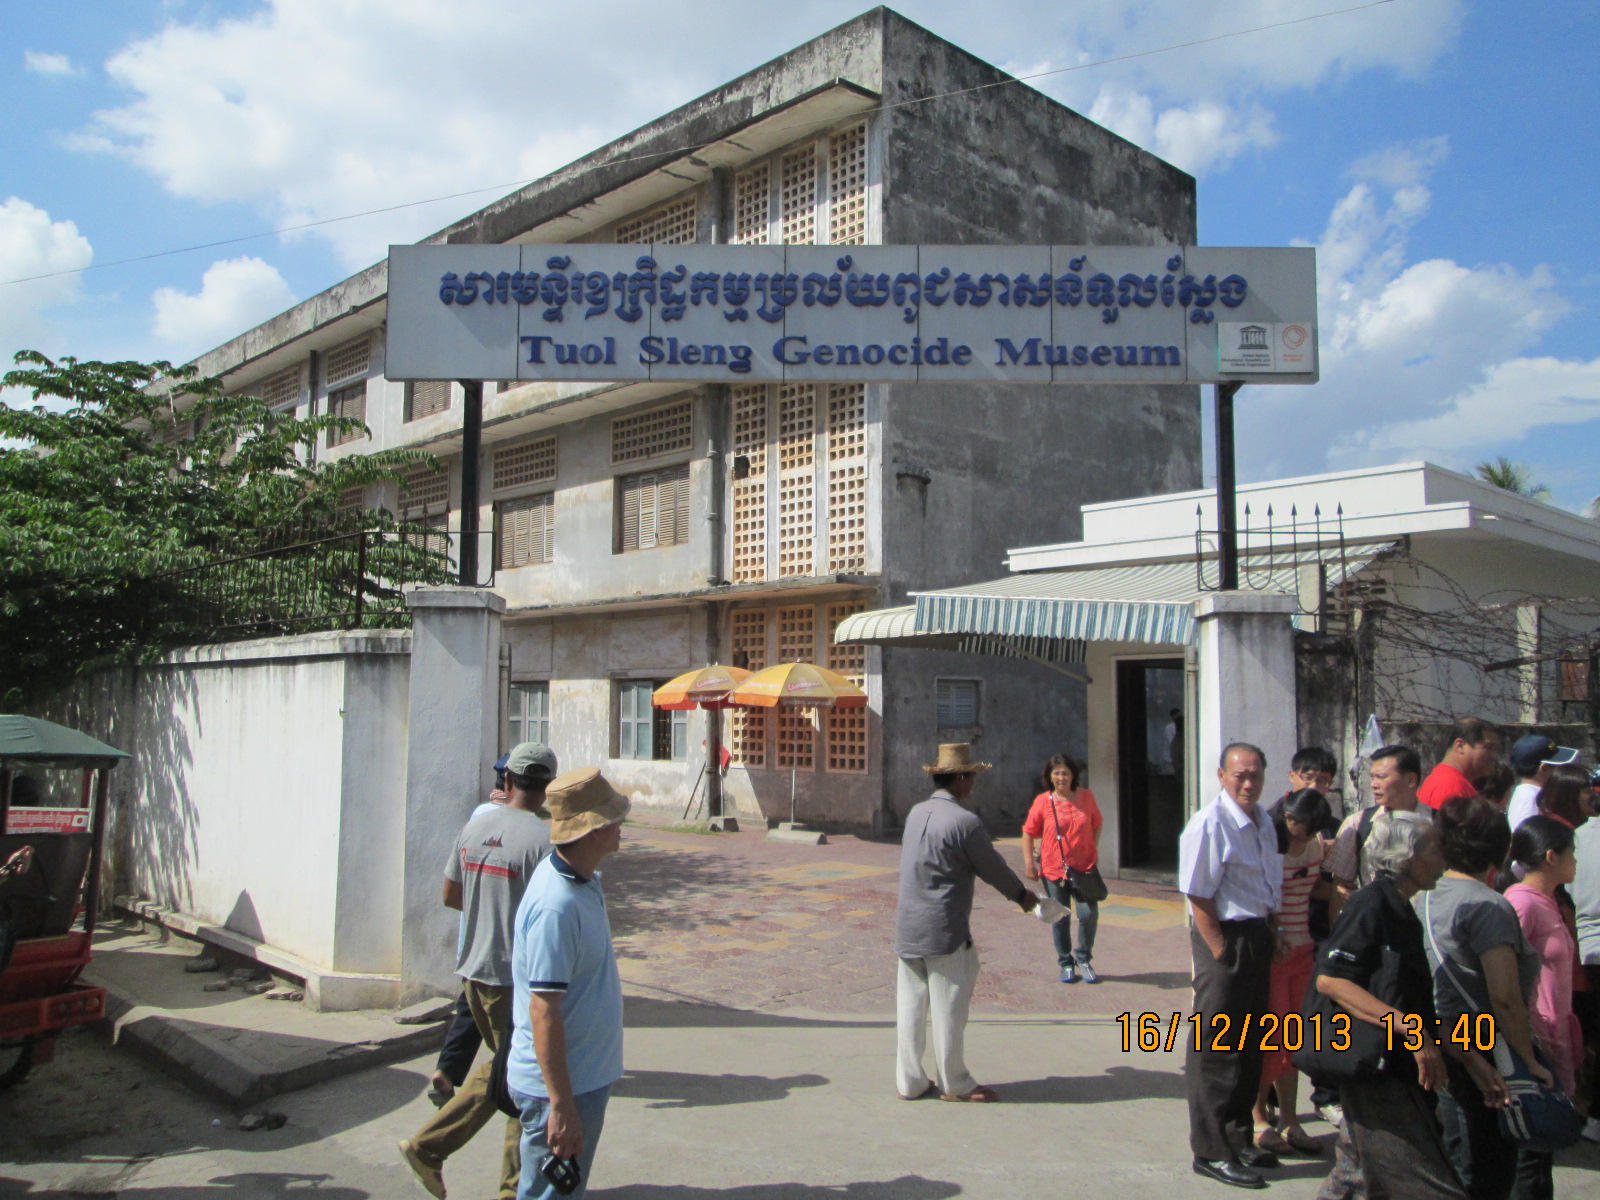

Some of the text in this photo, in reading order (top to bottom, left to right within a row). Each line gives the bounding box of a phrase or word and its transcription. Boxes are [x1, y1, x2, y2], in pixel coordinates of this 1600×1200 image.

[519, 335, 1182, 373] Tuol Sleng Genocide Museum
